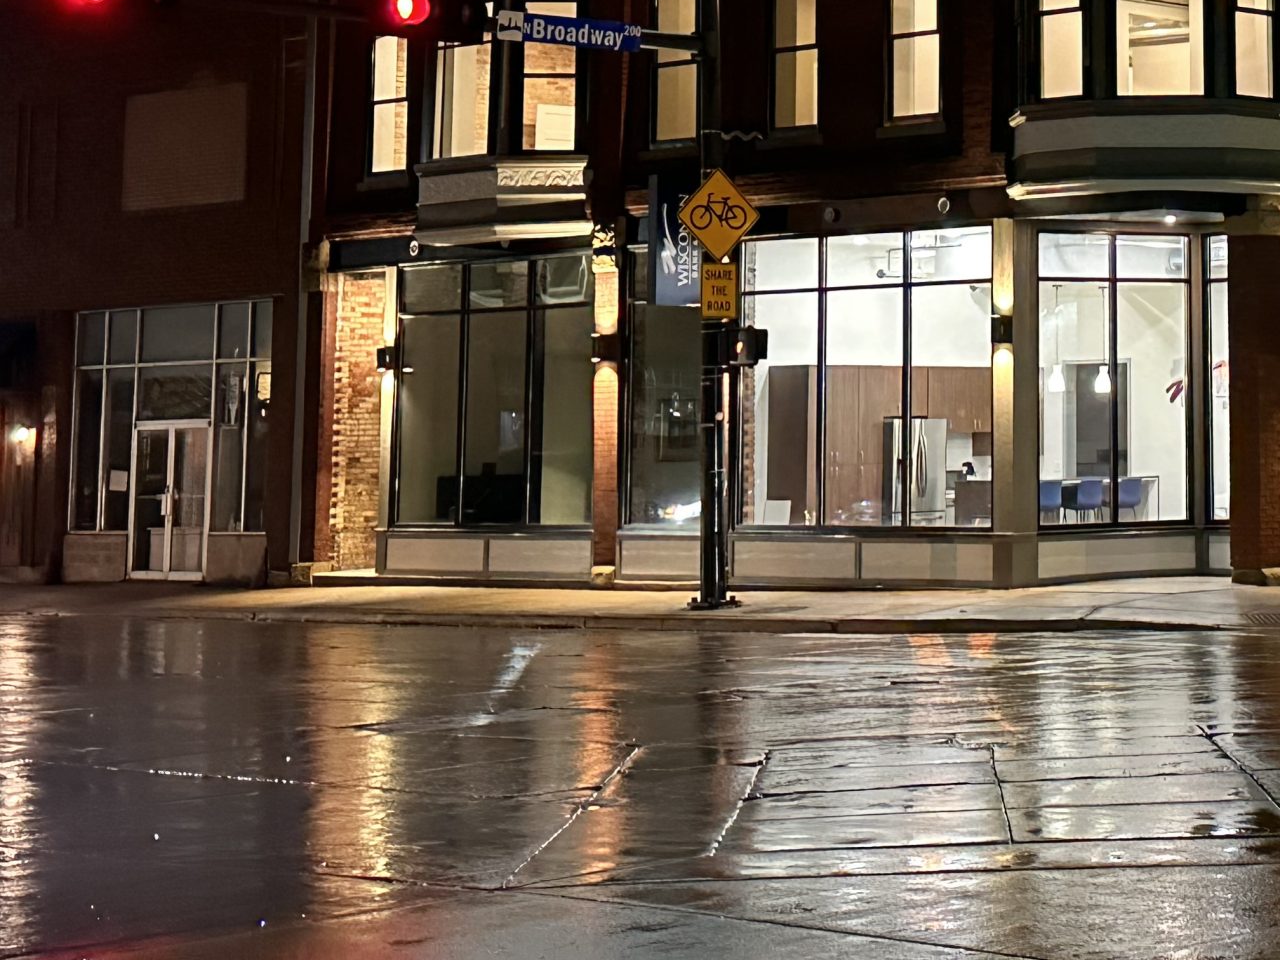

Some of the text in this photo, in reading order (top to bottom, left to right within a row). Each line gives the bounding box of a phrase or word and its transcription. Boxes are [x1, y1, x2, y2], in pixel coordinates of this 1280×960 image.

[523, 18, 642, 51] N Broadway 200
[704, 269, 734, 281] SHARE
[711, 285, 728, 296] THE
[707, 300, 732, 312] ROAD
